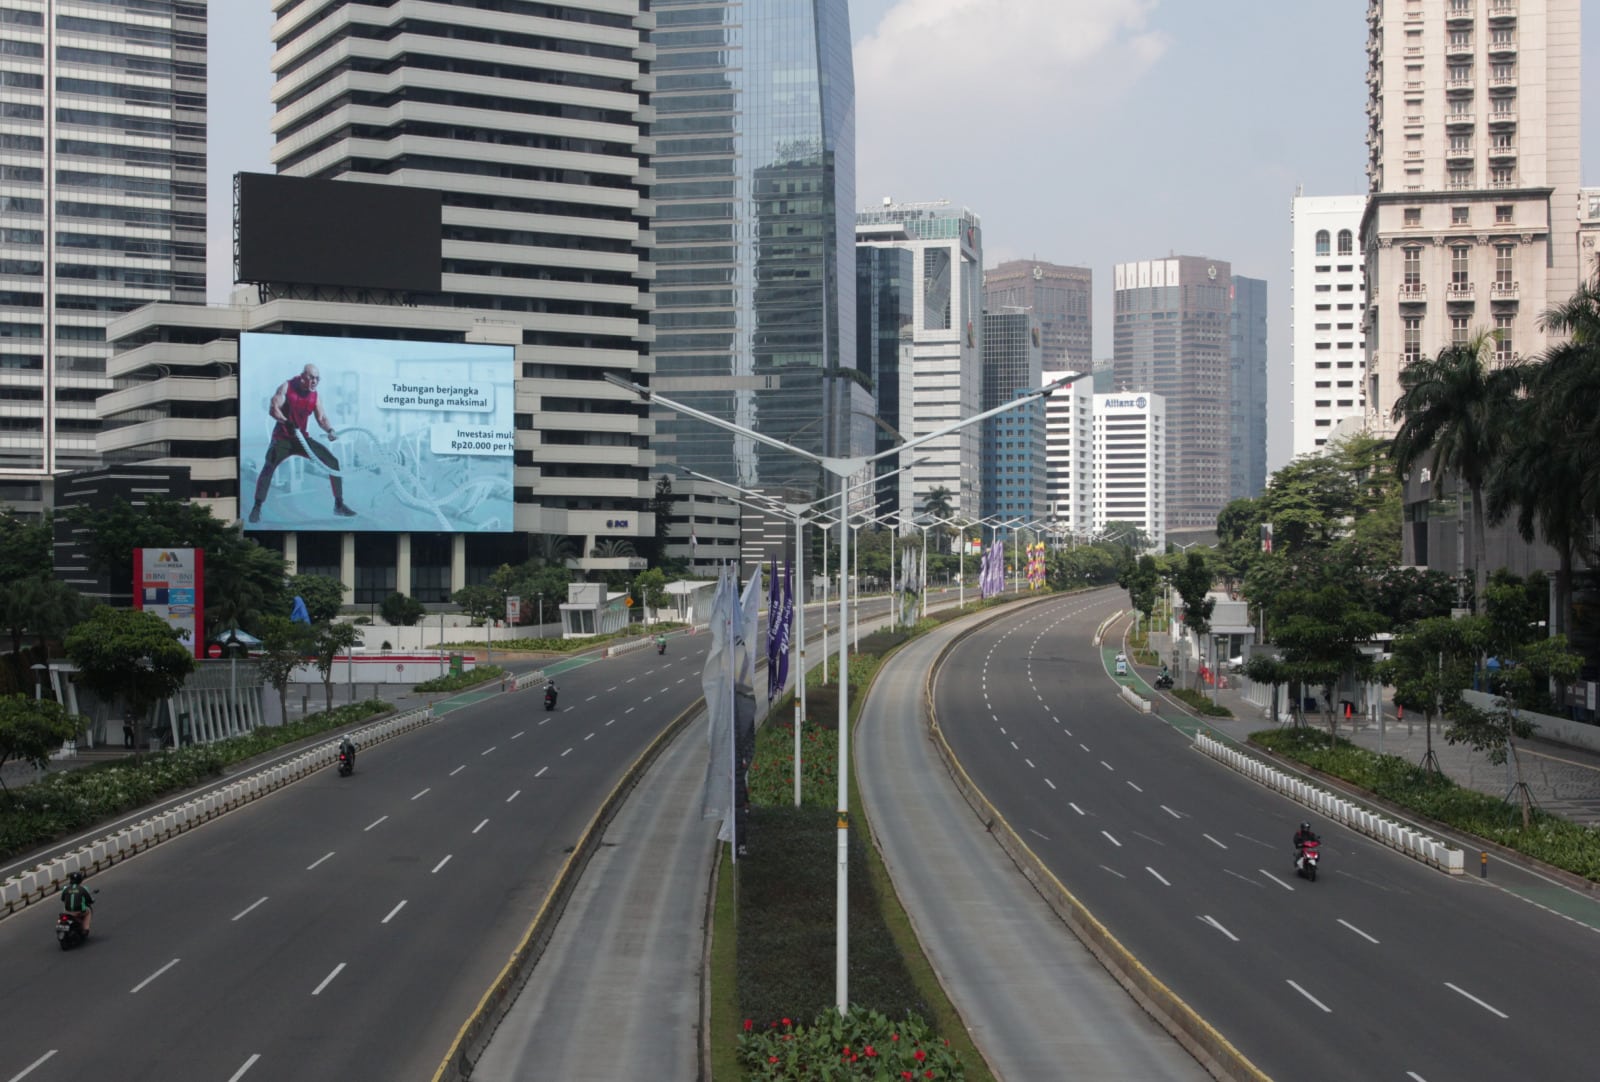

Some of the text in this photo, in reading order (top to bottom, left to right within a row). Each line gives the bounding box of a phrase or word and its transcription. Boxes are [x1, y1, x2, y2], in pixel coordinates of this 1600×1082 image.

[392, 383, 479, 397] Tabungan berjangka
[383, 394, 487, 407] dengan bunga maksimal
[1105, 398, 1134, 408] Allianz
[457, 429, 494, 439] Investasi
[451, 440, 491, 451] Rp20.000
[493, 443, 507, 452] per
